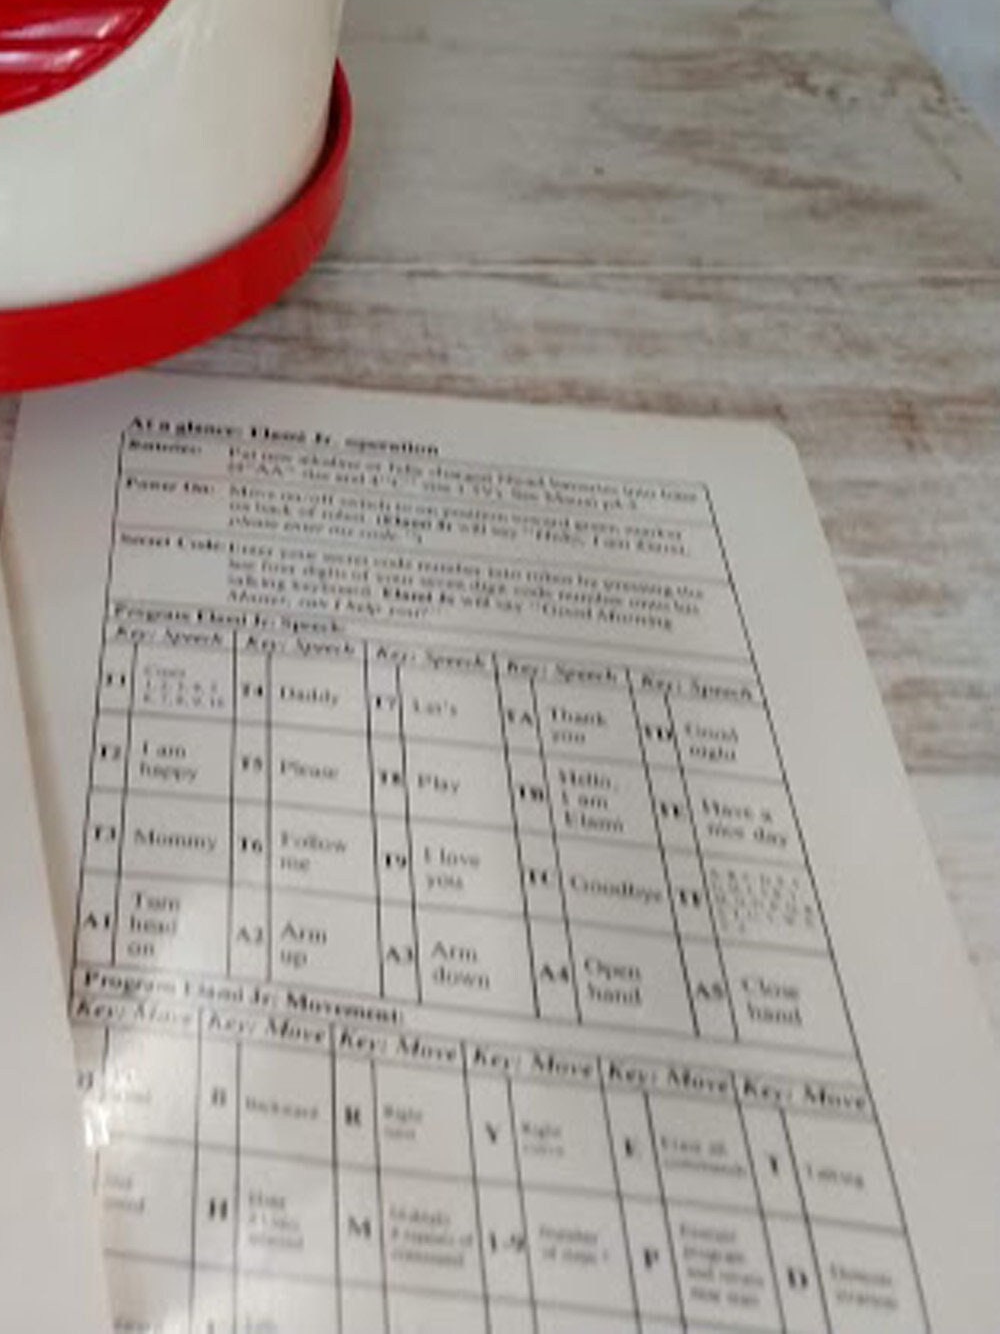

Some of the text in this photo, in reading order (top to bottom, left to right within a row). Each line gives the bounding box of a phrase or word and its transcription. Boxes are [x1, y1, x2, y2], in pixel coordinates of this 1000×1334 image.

[345, 437, 438, 456] operation
[114, 604, 189, 623] Program
[280, 685, 338, 706] Daddy
[140, 759, 197, 783] happy
[417, 772, 459, 794] Play
[133, 828, 218, 853] Mommy
[281, 829, 348, 854] Follow
[281, 921, 329, 946] Arm
[281, 950, 309, 970] up
[431, 940, 478, 964] Arm
[84, 969, 177, 996] Program
[432, 965, 491, 991] down
[263, 1014, 327, 1047] Move
[396, 1037, 460, 1063] Move
[530, 1049, 595, 1081] Move
[665, 1065, 730, 1095] Move
[801, 1083, 870, 1113] Move
[348, 1216, 372, 1241] M
